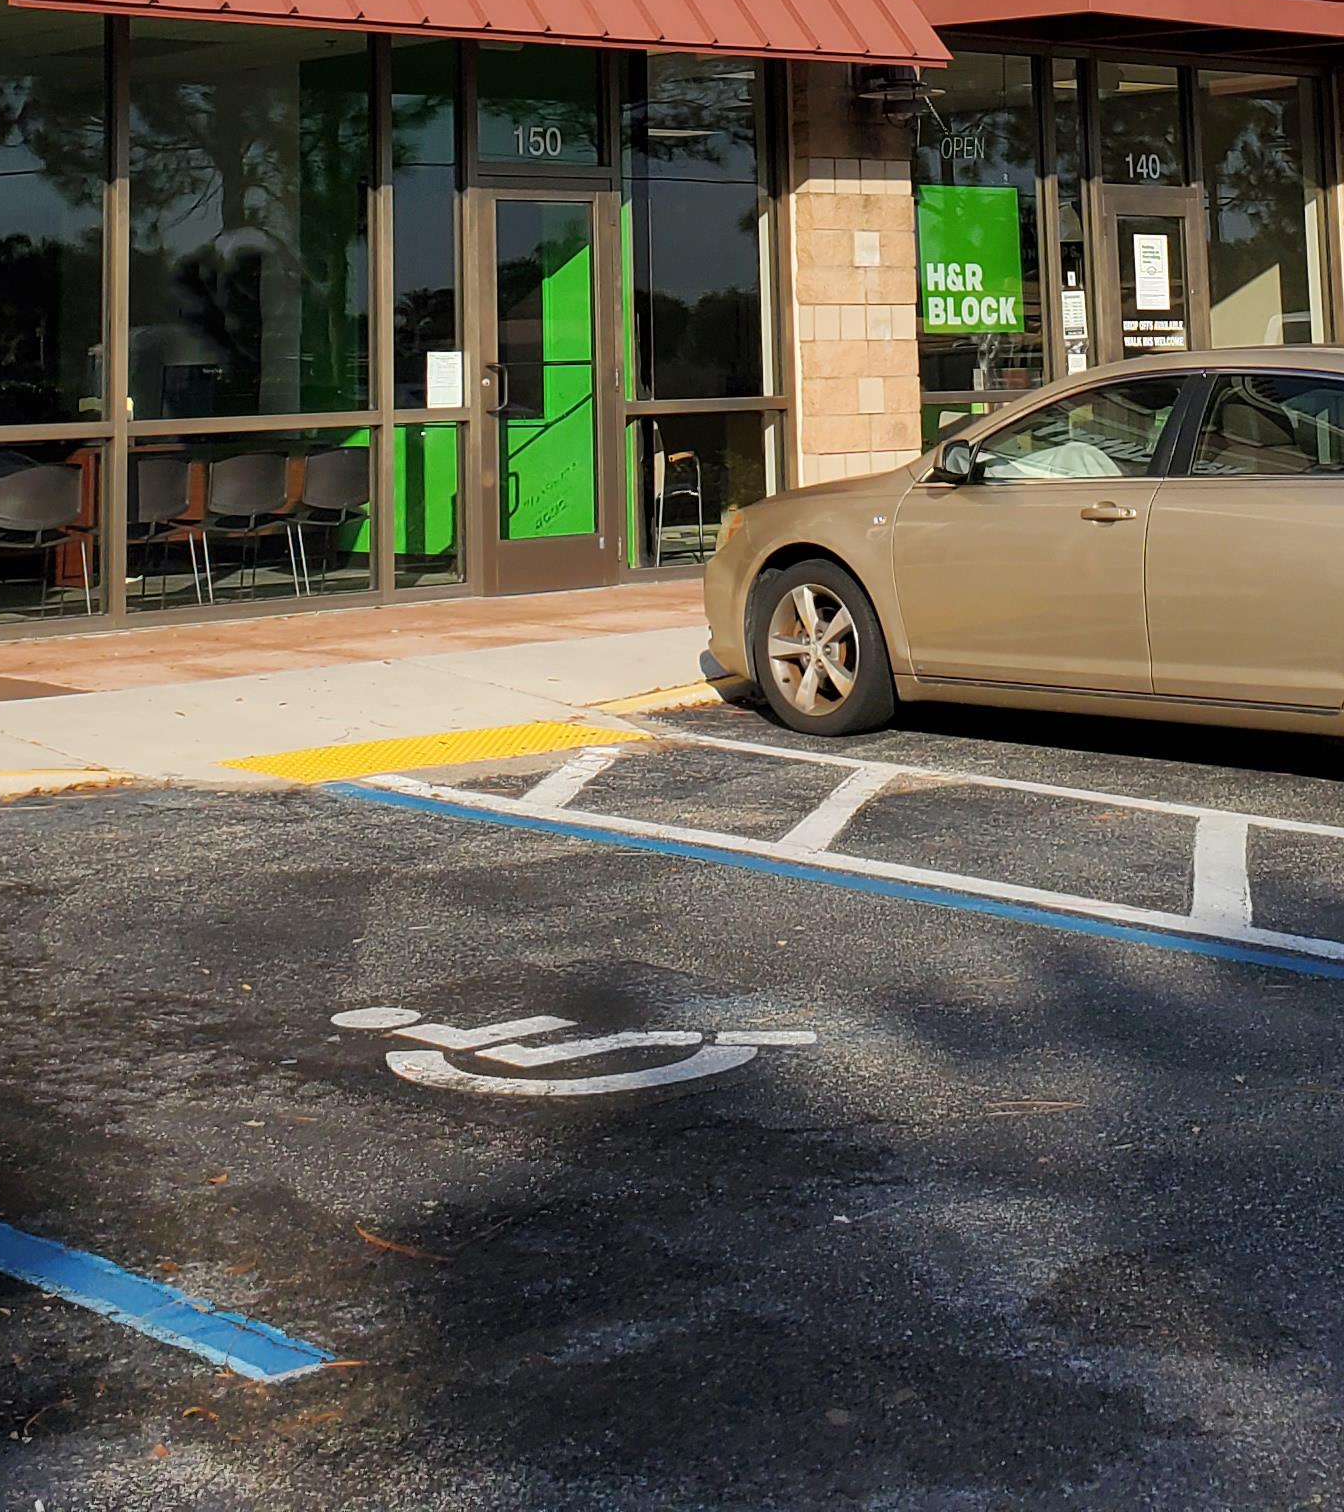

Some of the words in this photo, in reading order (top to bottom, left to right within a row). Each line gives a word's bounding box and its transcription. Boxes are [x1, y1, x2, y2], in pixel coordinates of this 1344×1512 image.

[512, 125, 563, 156] 150
[940, 136, 986, 160] OPEN
[1124, 152, 1161, 180] 140
[925, 262, 984, 292] H&R
[927, 296, 1017, 326] BLOCK
